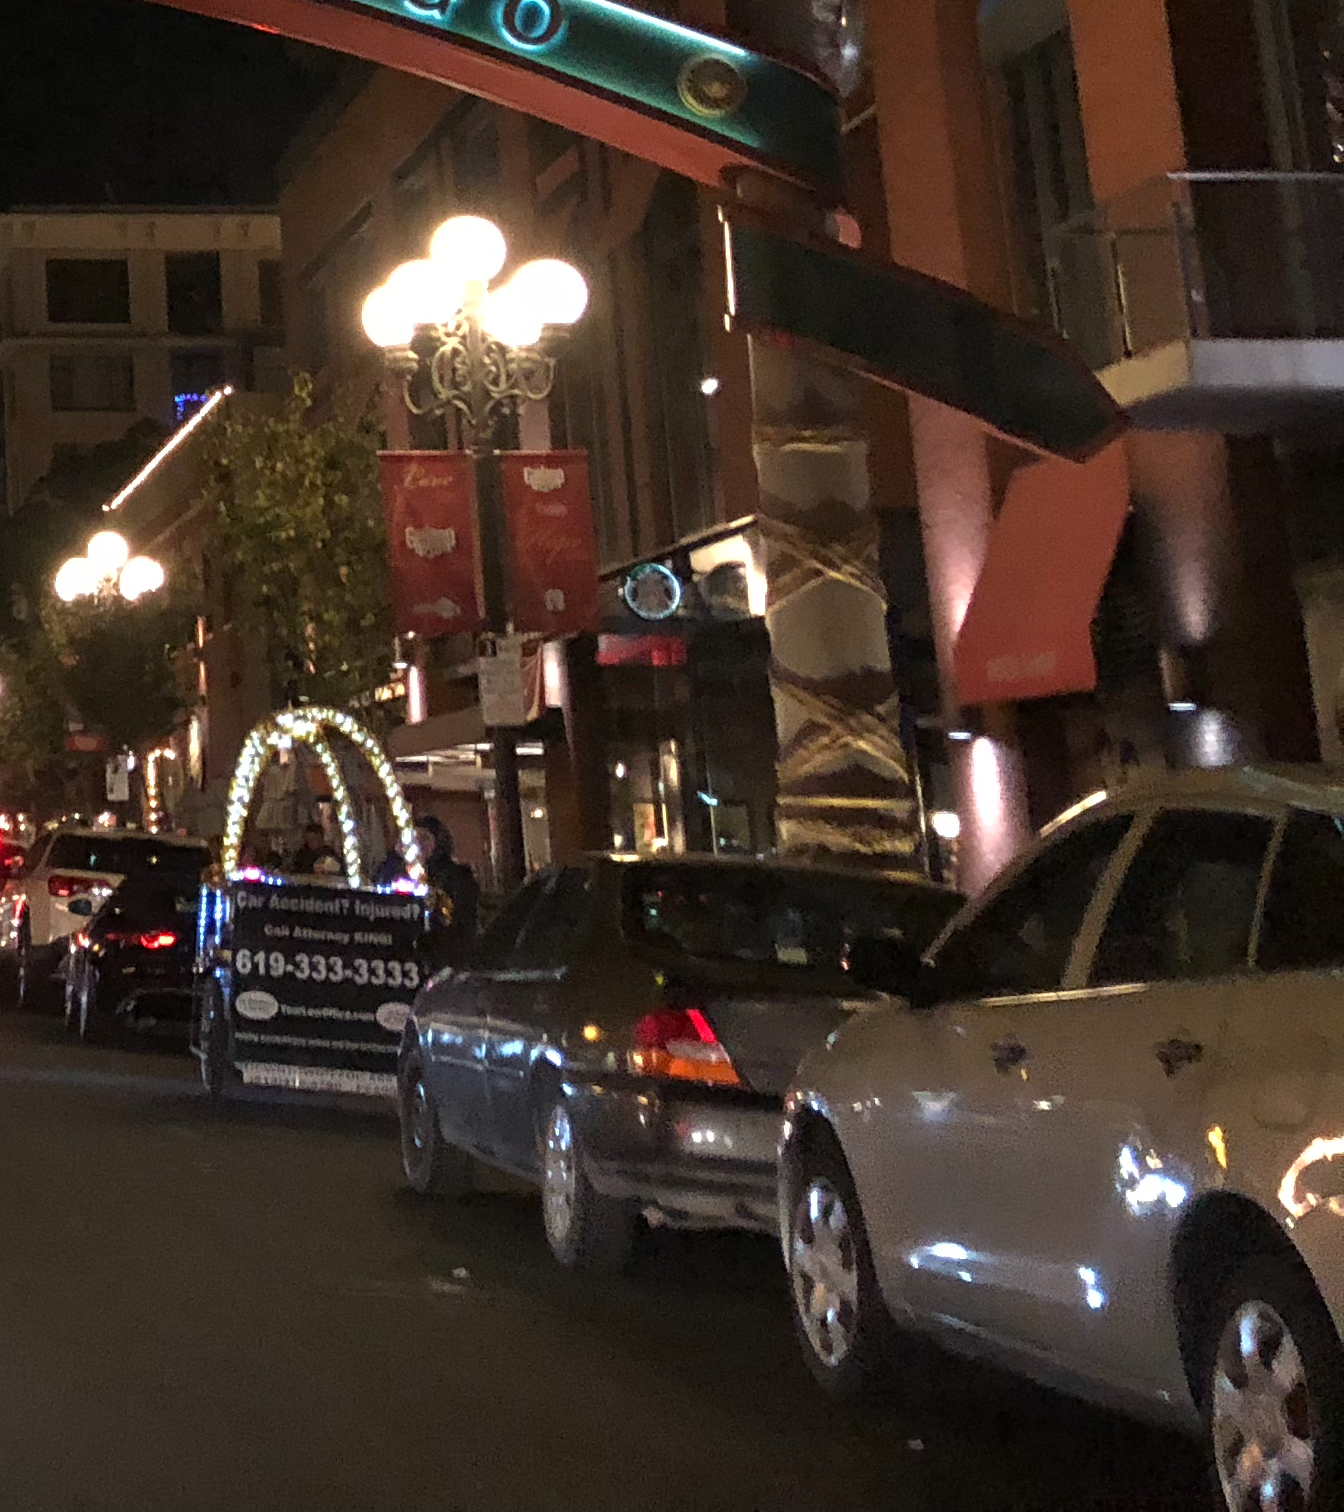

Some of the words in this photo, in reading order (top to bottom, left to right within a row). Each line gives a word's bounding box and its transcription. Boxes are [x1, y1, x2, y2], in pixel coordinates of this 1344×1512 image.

[236, 889, 264, 909] Car
[269, 892, 350, 915] Accident?
[354, 897, 421, 923] Injured?
[292, 924, 351, 946] Attorney
[235, 947, 420, 990] 619-333-3333
